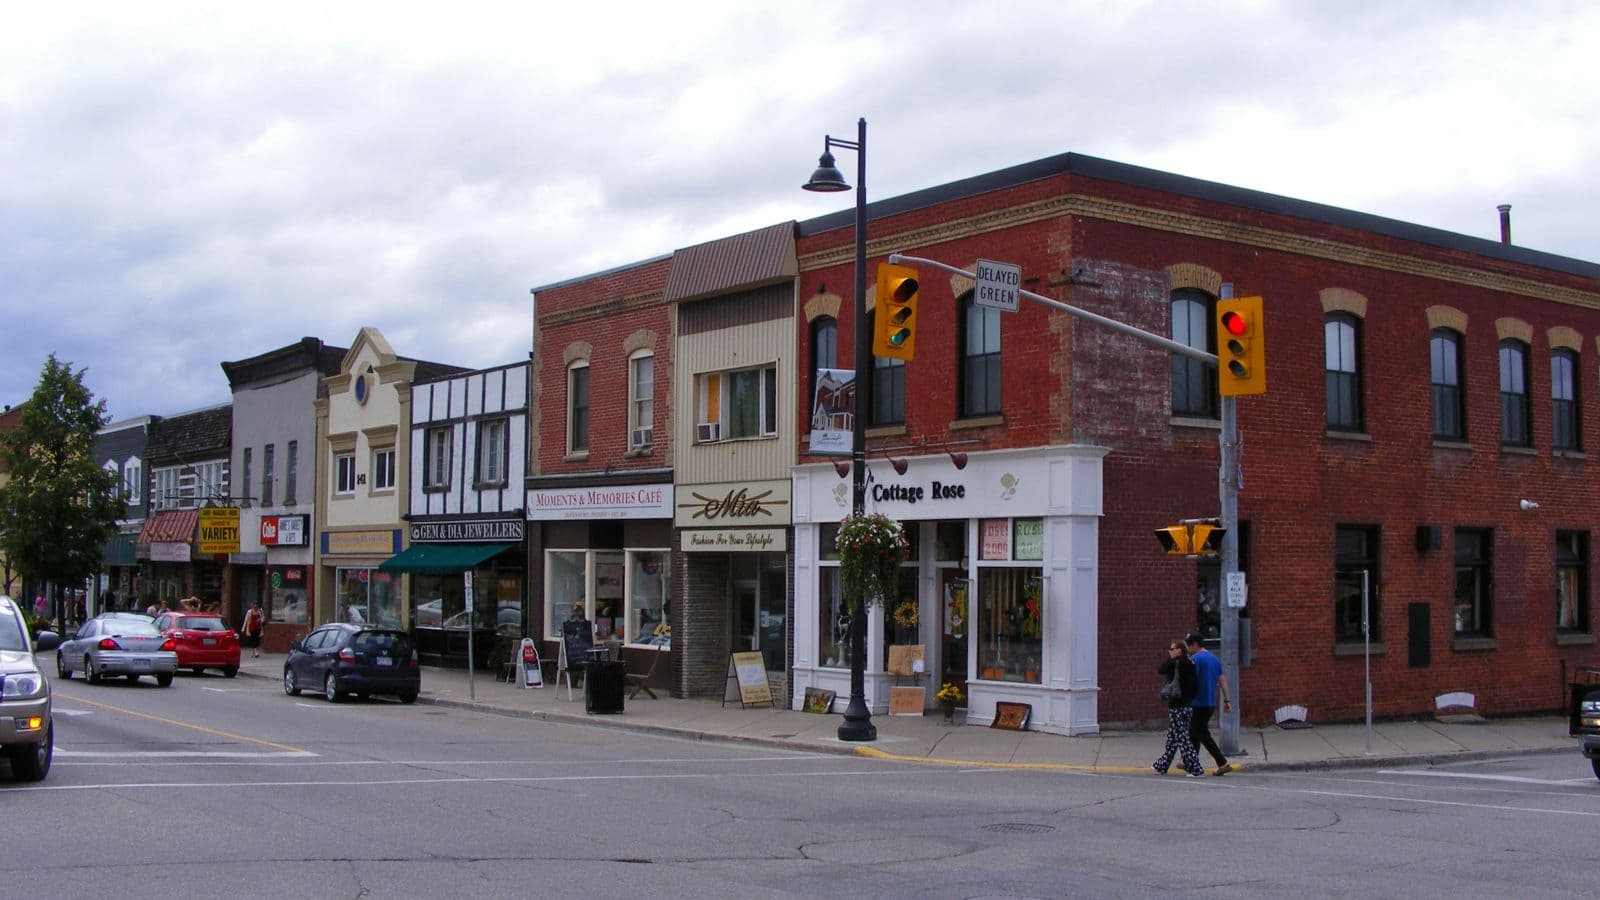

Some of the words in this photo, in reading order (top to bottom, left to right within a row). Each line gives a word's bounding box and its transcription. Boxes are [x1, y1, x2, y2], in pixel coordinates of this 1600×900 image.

[979, 267, 1018, 285] DELAYED
[980, 286, 1014, 304] GREEN
[536, 493, 577, 507] MOMENTS
[579, 496, 585, 505] &
[587, 490, 636, 505] MEMORIES
[873, 484, 924, 504] Cottage
[932, 481, 965, 500] Rose
[202, 528, 238, 540] VARIETY
[420, 524, 439, 539] GEM
[440, 524, 446, 538] &
[447, 524, 463, 539] DIA
[463, 522, 522, 538] JEWELLERS
[690, 533, 715, 546] Fashion
[715, 533, 727, 545] For
[728, 532, 744, 545] Your
[745, 531, 773, 549] Lifestyle
